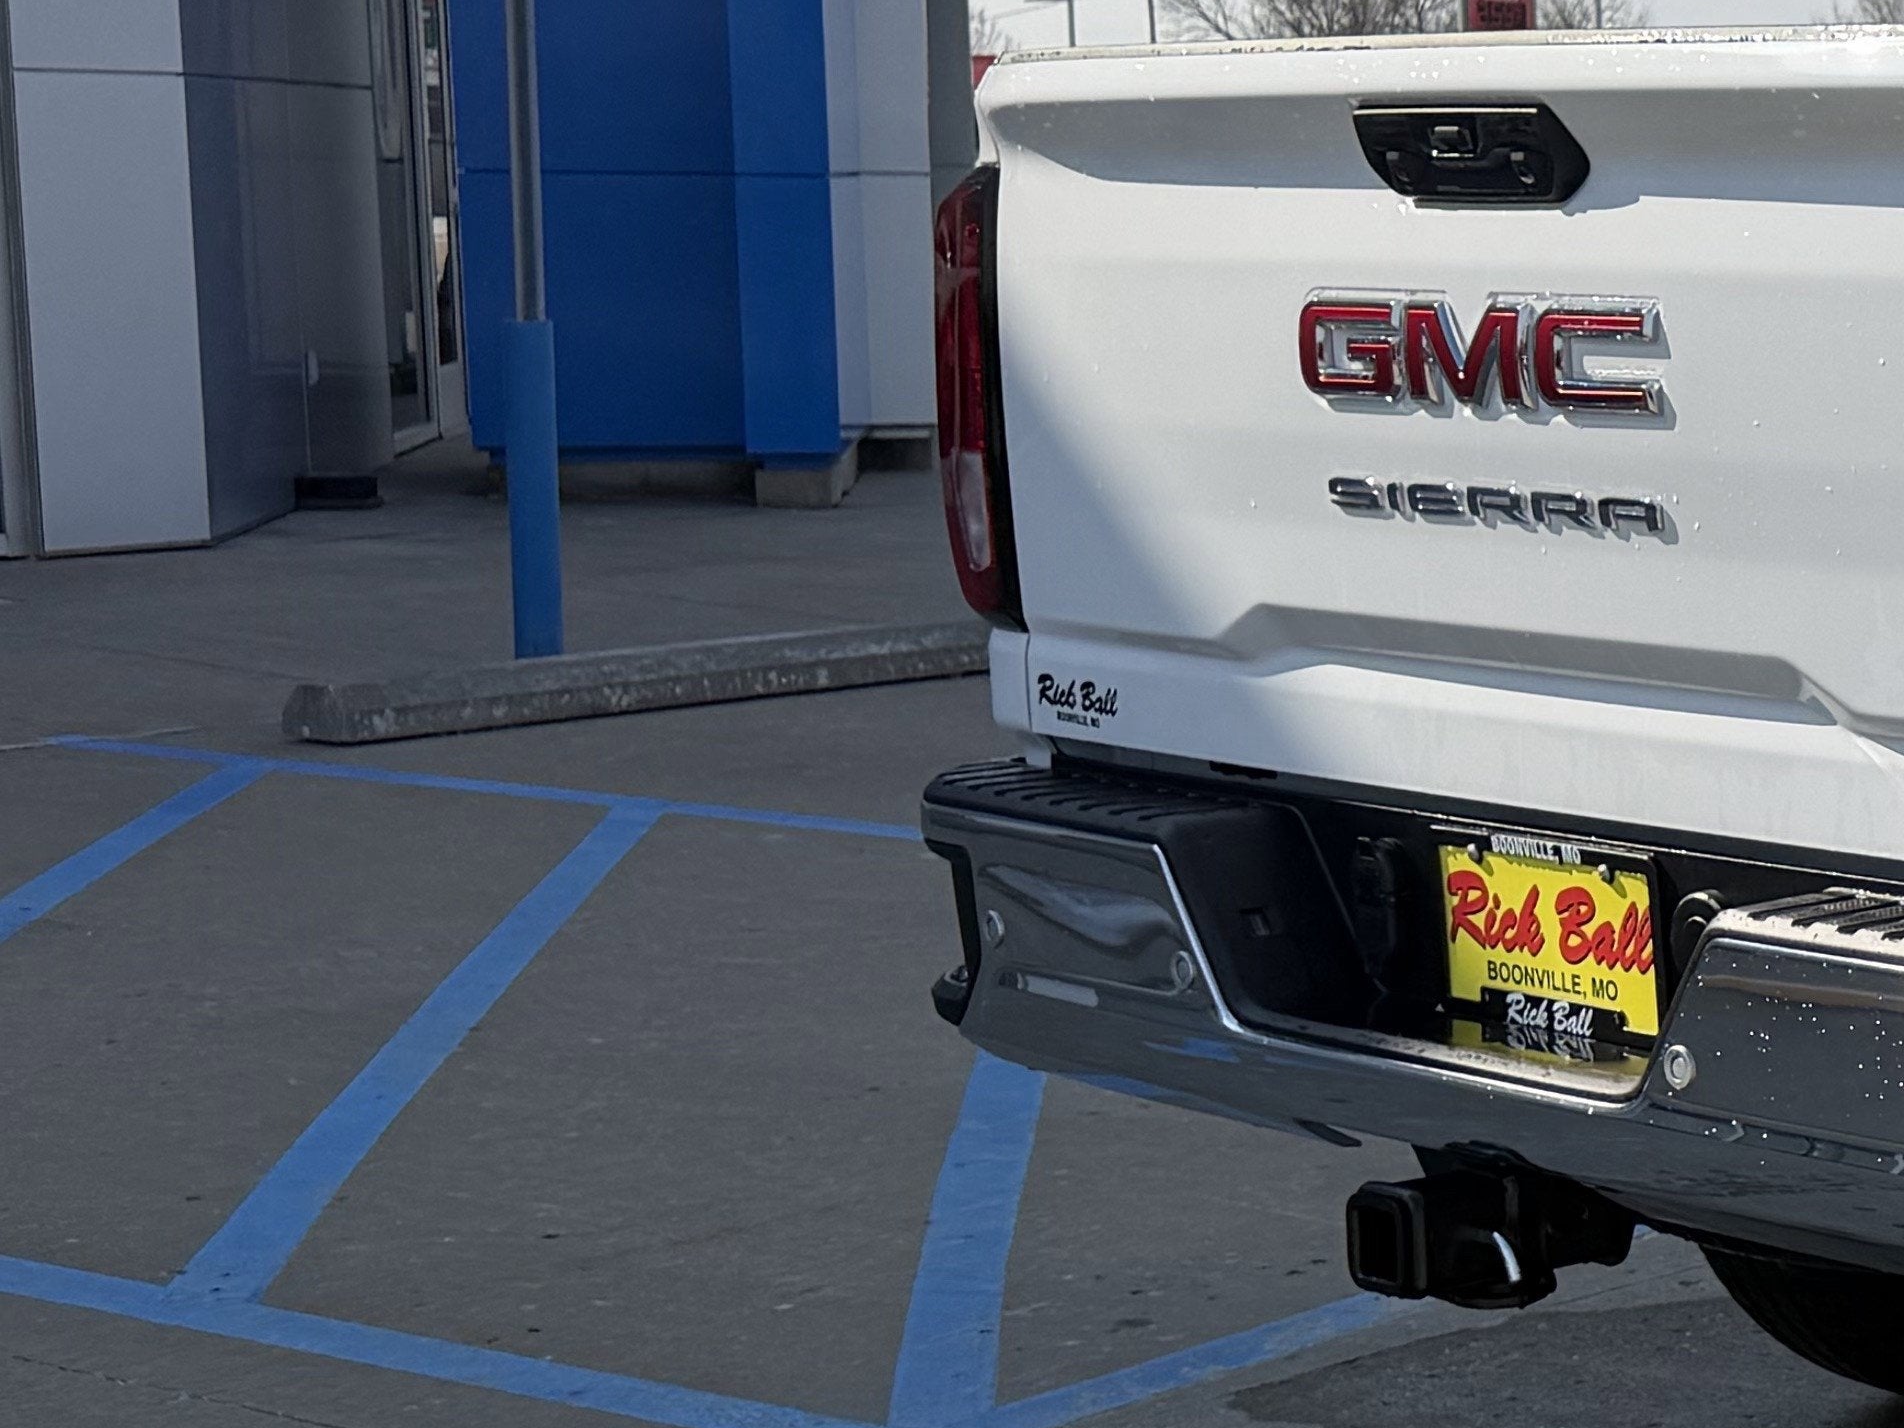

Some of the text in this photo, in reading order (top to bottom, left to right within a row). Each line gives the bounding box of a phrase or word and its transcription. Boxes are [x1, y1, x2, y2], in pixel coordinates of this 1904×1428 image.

[1299, 299, 1665, 418] GMC
[1328, 475, 1668, 534] SIERRA
[1037, 673, 1118, 717] Rick Ball
[1490, 834, 1582, 865] BOONVILLE, MO
[1446, 870, 1654, 975] Rick Ball
[1487, 959, 1619, 1002] BOONVILLE, MO
[1504, 993, 1594, 1037] Rick Ball
